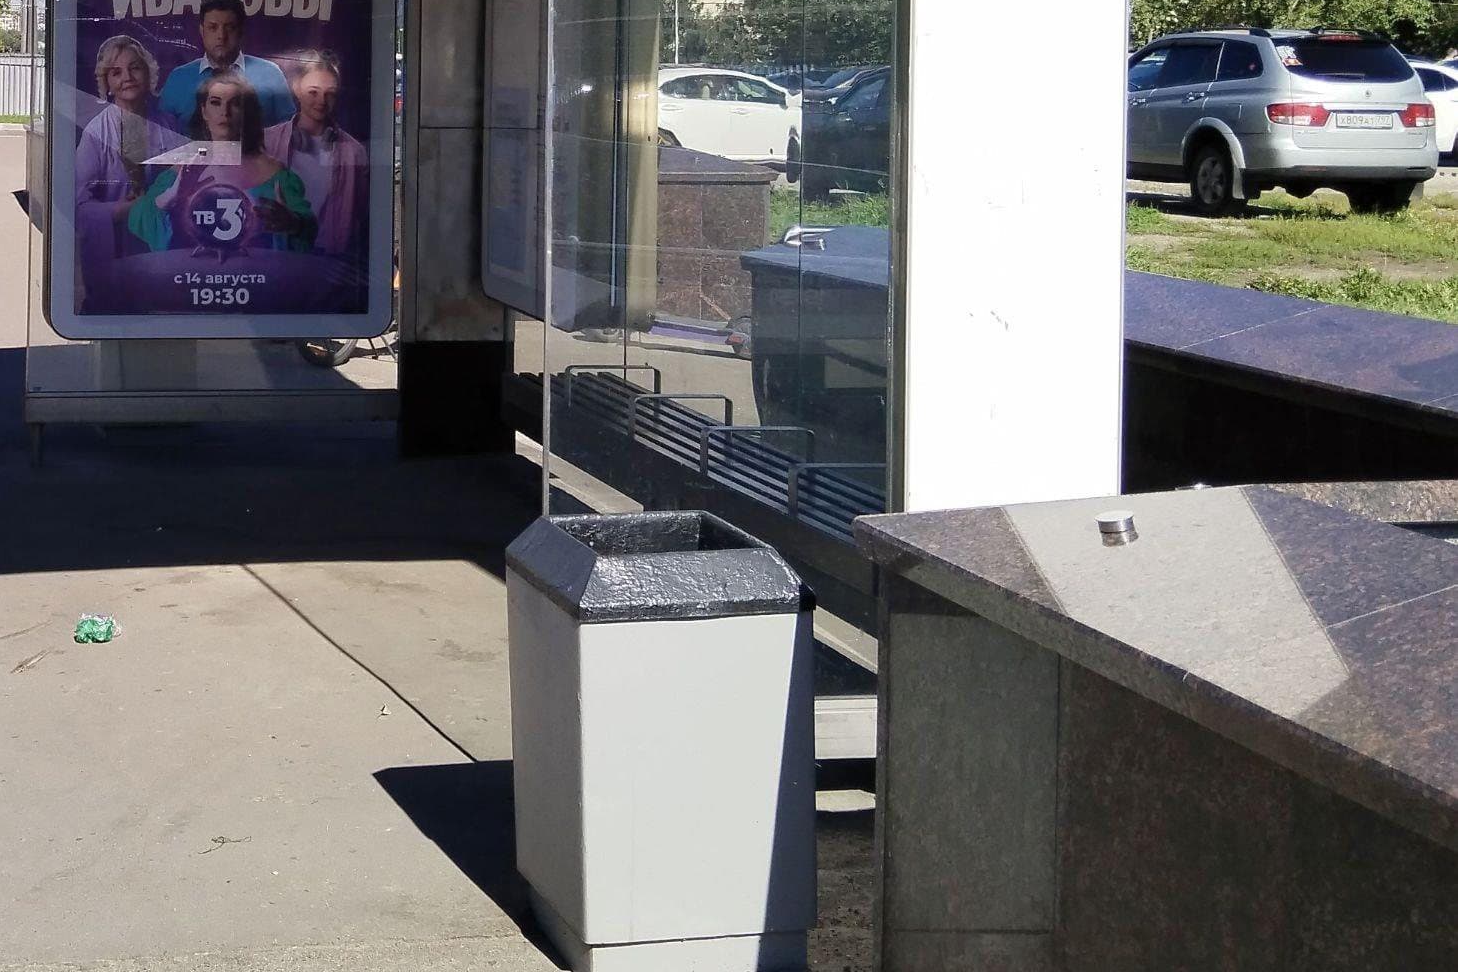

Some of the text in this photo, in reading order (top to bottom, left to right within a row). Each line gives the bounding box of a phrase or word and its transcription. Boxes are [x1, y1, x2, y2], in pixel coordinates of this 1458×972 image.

[173, 273, 266, 287] с 14 августа
[190, 287, 250, 305] 19:30
